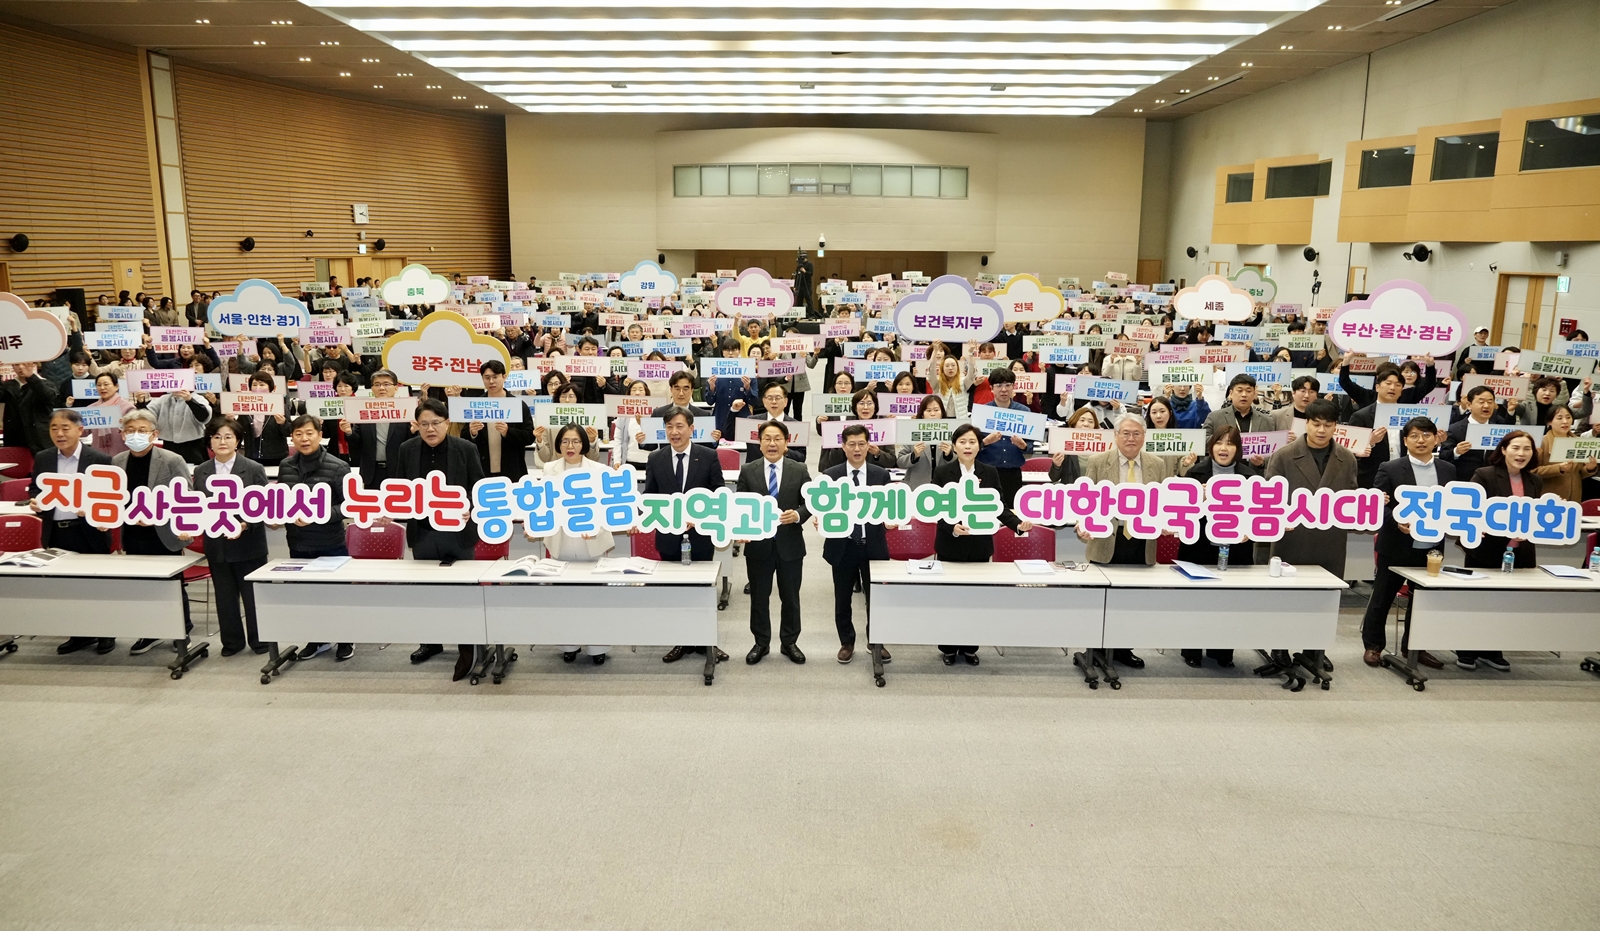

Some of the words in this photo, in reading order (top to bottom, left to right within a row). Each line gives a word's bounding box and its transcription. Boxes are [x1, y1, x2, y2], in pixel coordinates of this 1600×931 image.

[407, 288, 424, 296] 충북
[733, 297, 776, 307] 대구·경북
[1014, 302, 1034, 312] 전북
[1204, 301, 1224, 311] 세종
[218, 313, 300, 327] 서울·인천·경기
[914, 315, 982, 330] 보건복지부
[1342, 322, 1453, 341] 부산·울산·경남
[412, 356, 482, 373] 광주·전남
[1541, 356, 1572, 365] 대한민국
[1094, 381, 1120, 390] 대한민국
[82, 416, 111, 426] 봄시대!
[994, 411, 1024, 423] 대한민국
[41, 469, 124, 522] 지금
[128, 478, 326, 533] 사는곳에서
[346, 475, 464, 526] 누리는
[476, 469, 636, 539] 통합돌봄
[642, 493, 778, 542] 지역과
[1400, 486, 1576, 543] 전국대회
